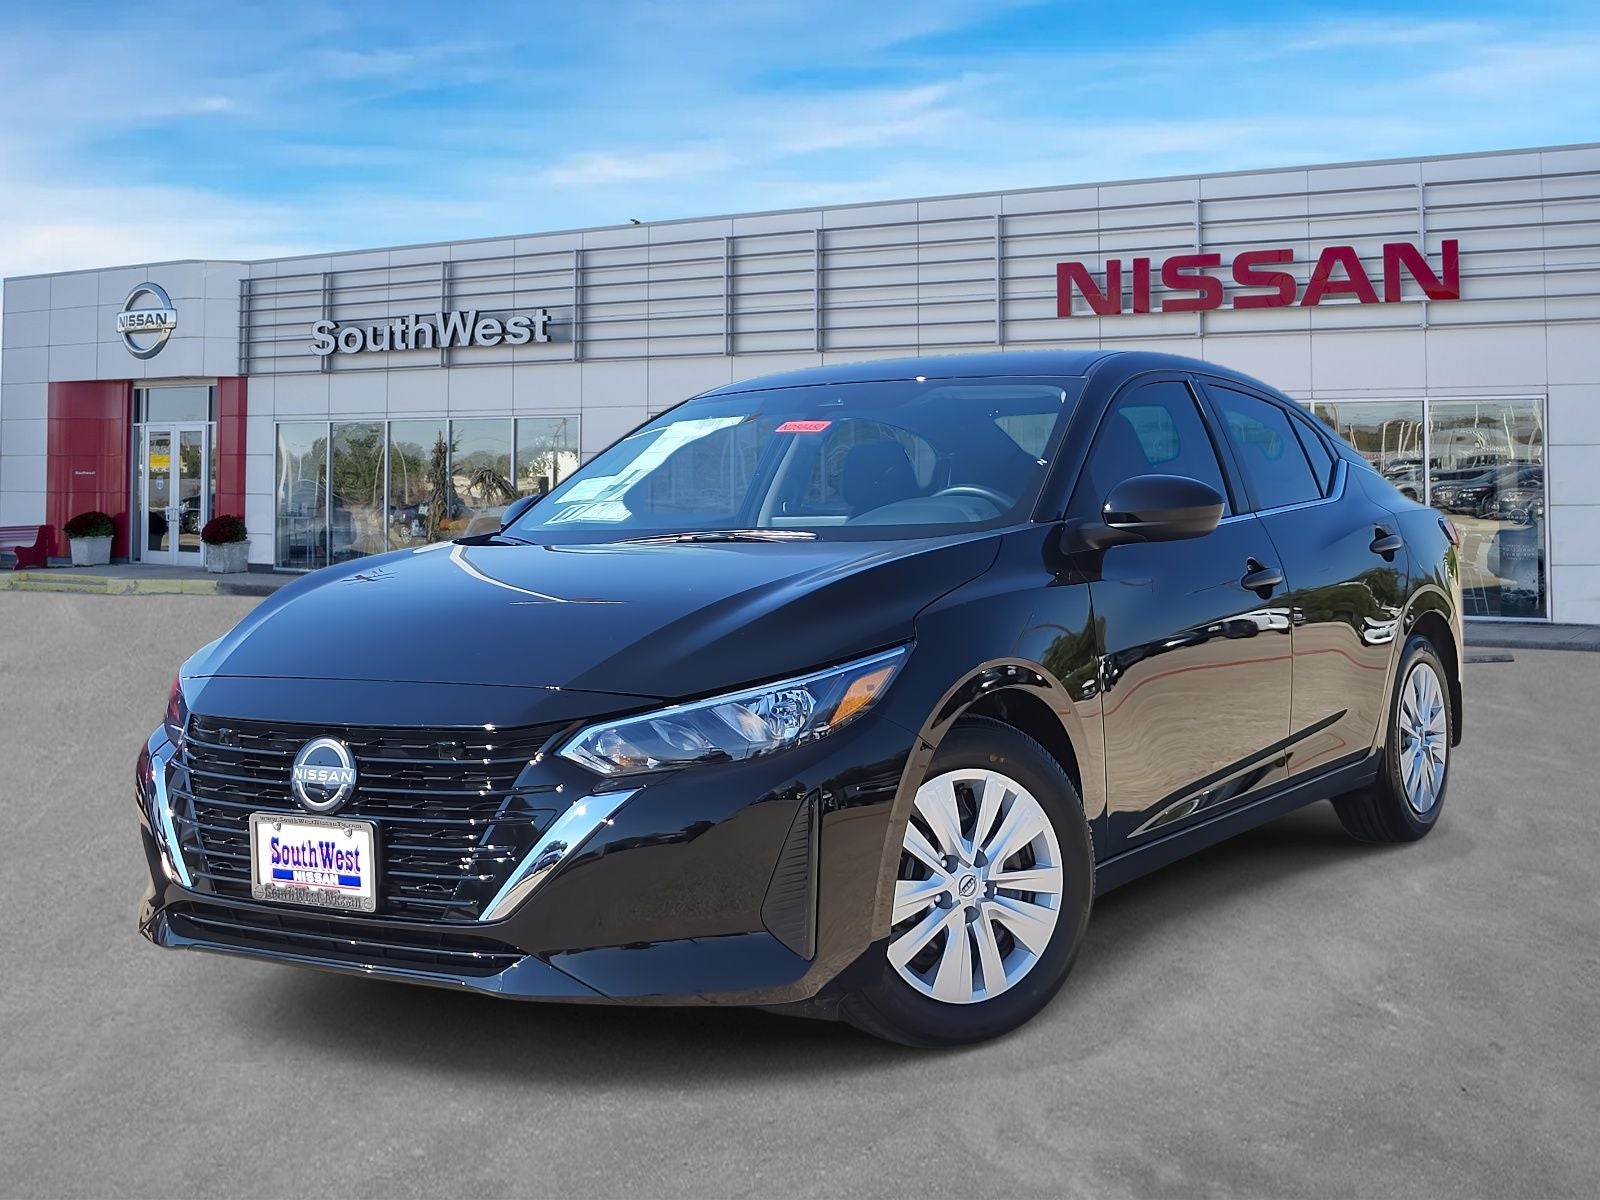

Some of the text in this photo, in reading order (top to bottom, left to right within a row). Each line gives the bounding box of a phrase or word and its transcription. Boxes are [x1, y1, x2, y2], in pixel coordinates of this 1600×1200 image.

[1056, 239, 1461, 318] NISSAN
[119, 312, 167, 328] NISSAN
[309, 308, 552, 356] SouthWest
[295, 767, 353, 783] NISSAN
[270, 836, 361, 873] SouthWest
[293, 870, 339, 886] NISSAN
